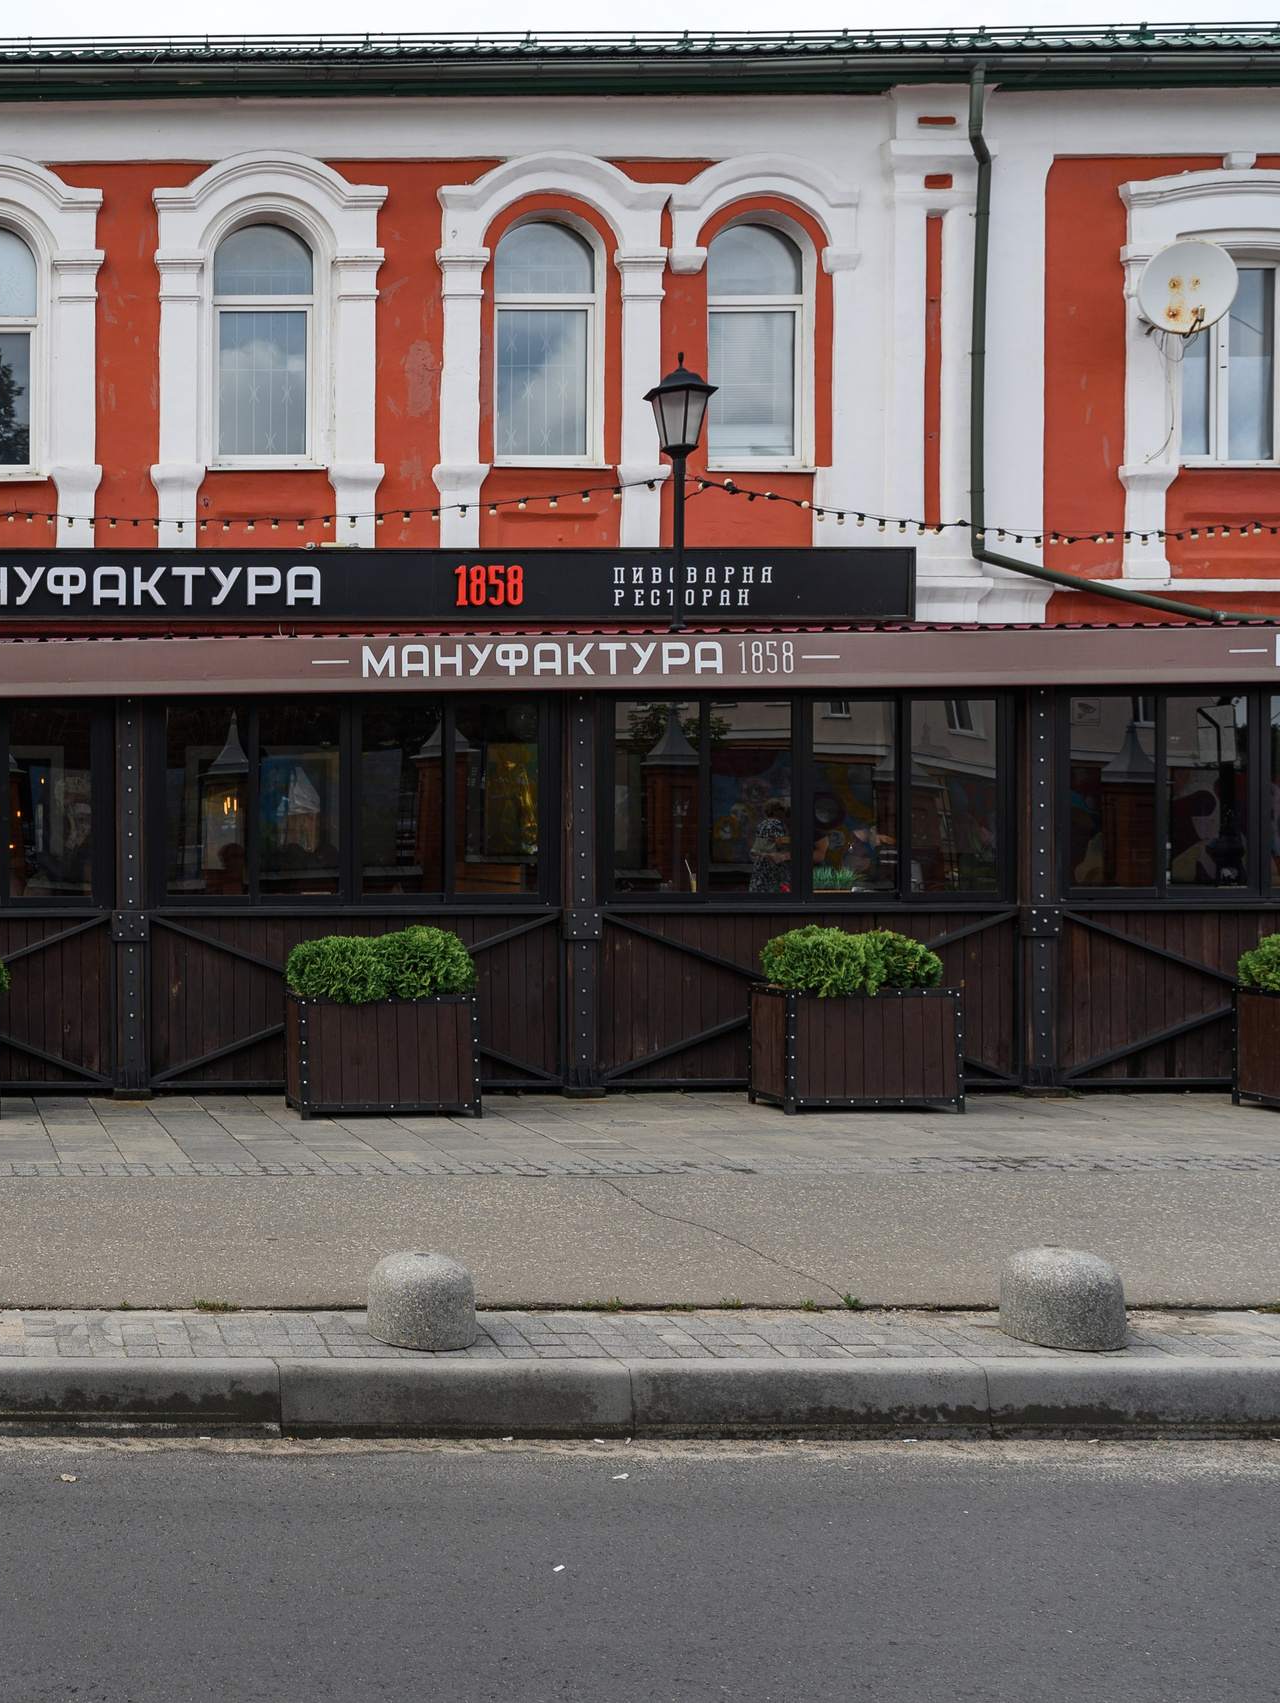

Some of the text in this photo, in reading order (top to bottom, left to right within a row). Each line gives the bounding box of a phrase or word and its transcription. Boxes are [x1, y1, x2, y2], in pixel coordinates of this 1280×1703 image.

[454, 564, 524, 607] 1858
[362, 640, 794, 678] МАНУФАКТУРА 1858
